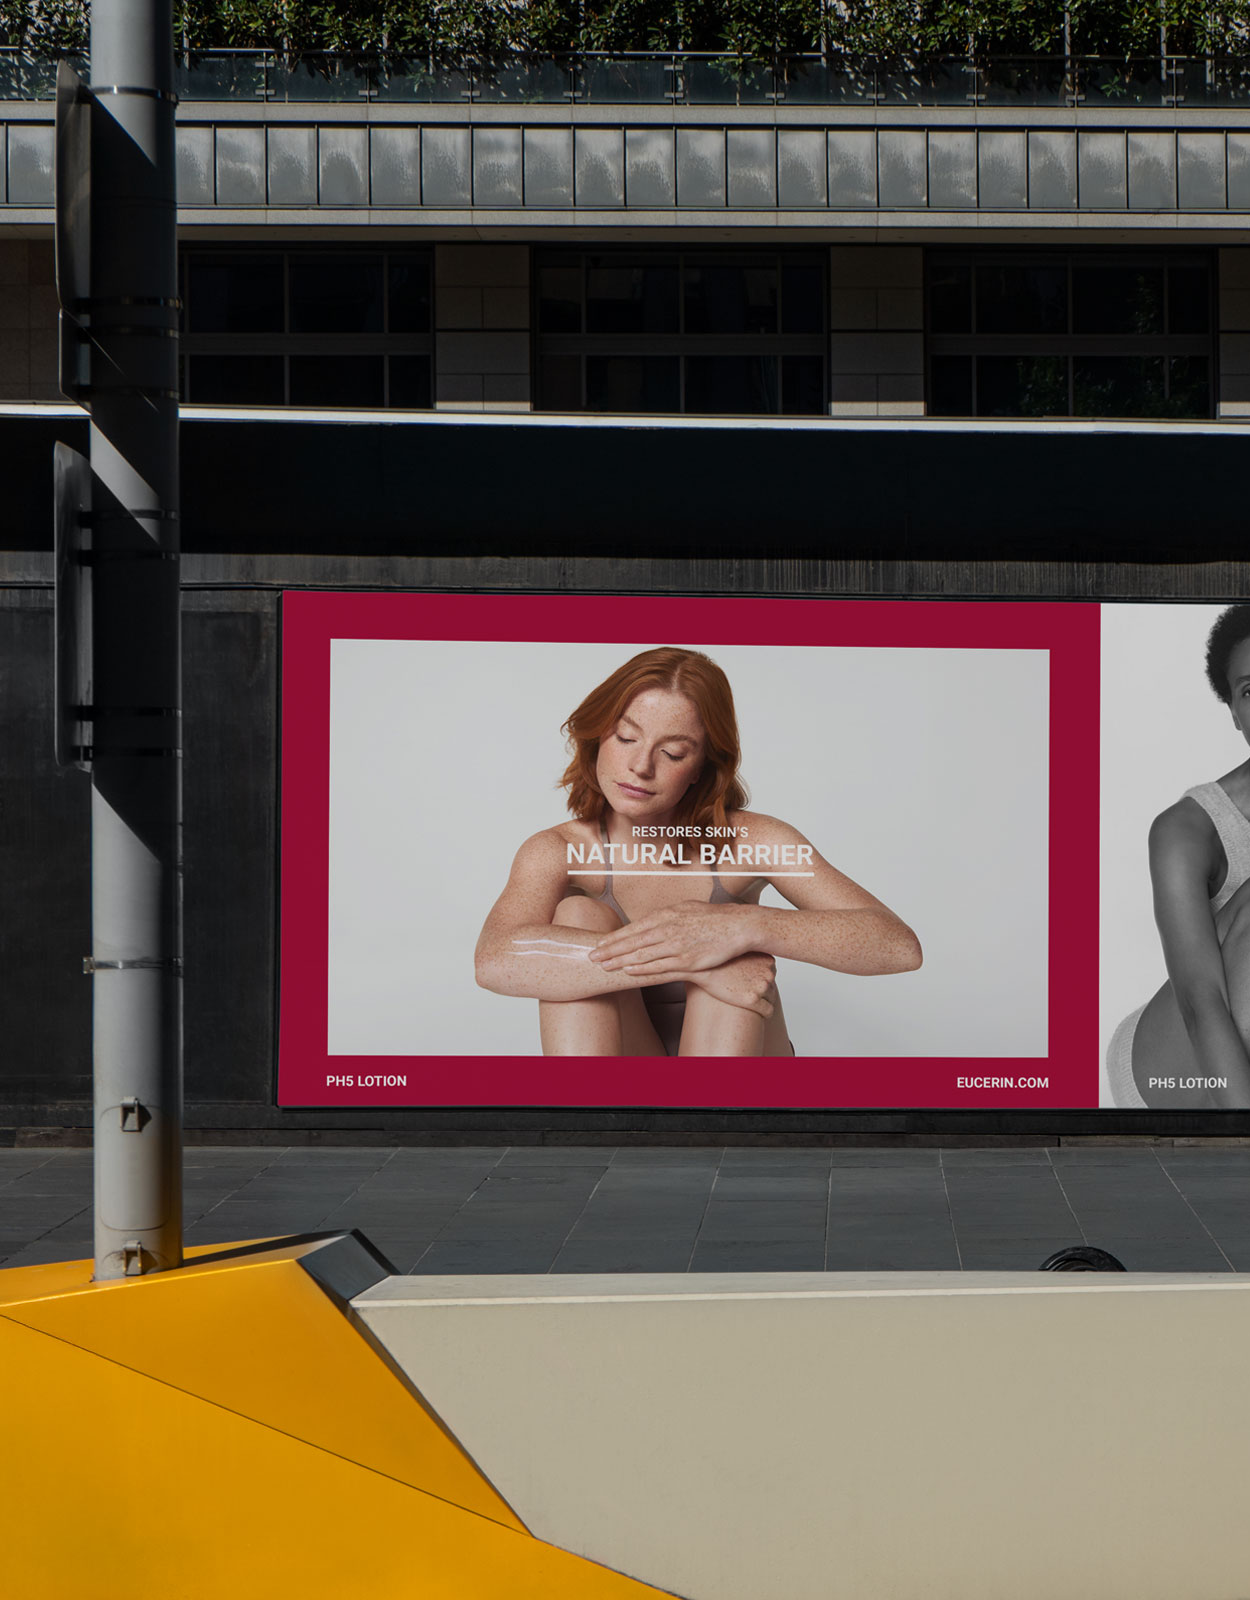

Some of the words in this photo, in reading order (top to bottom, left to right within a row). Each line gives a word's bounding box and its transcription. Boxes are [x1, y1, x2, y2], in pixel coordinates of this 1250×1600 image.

[632, 826, 701, 838] RESTORES
[705, 826, 749, 838] SKIN'S
[567, 843, 692, 865] NATURAL
[700, 844, 813, 866] BARRIER
[326, 1075, 354, 1087] PH5
[357, 1075, 407, 1087] LOTION
[956, 1077, 1049, 1089] EUCERIN.COM
[1148, 1077, 1176, 1089] PH5
[1179, 1077, 1228, 1089] LOTION
